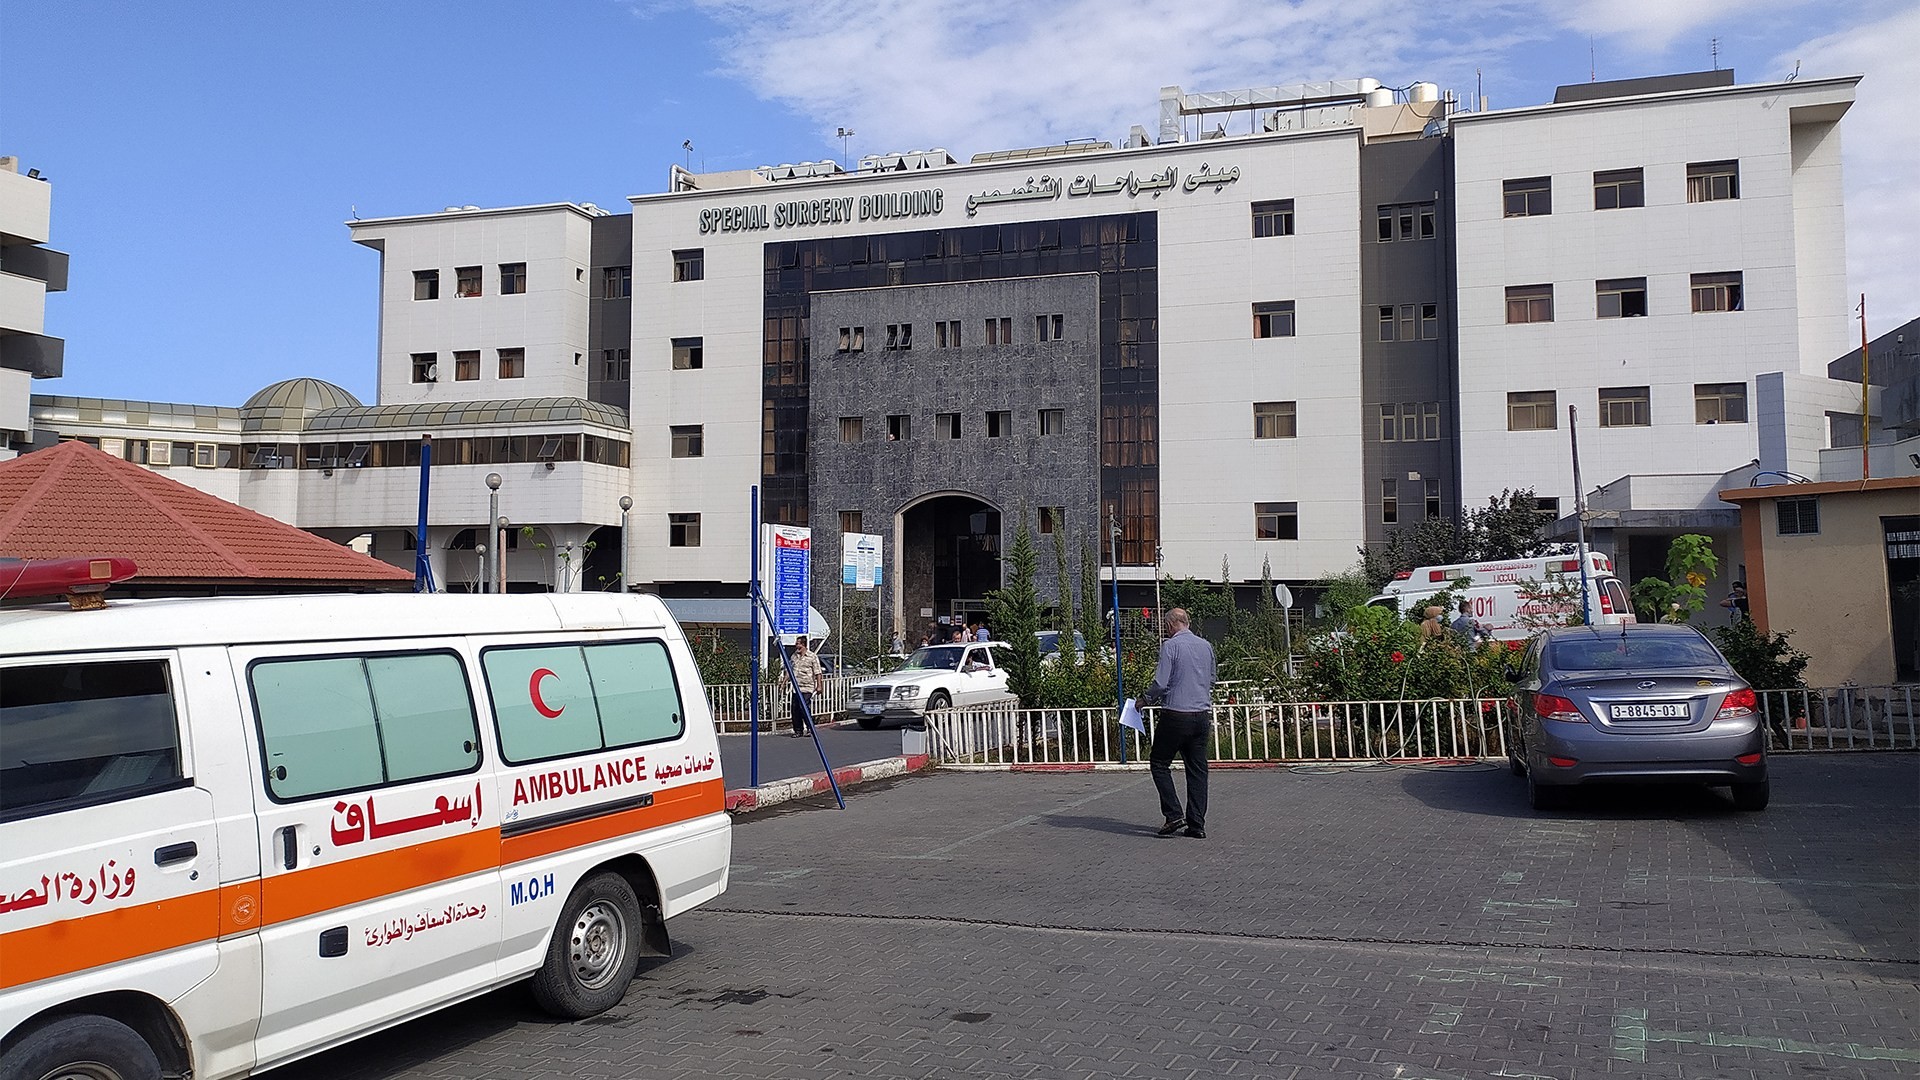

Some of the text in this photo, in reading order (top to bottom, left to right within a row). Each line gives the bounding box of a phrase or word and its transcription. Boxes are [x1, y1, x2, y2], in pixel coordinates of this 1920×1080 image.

[700, 188, 944, 233] SPECIAL SURGERY BUILDING
[967, 162, 1241, 218] مبنى الجراحات التخصصي
[1614, 705, 1676, 717] 3-8845-03
[513, 756, 647, 806] AMBULANCE
[685, 752, 714, 774] خدمات
[330, 780, 482, 846] إسعاف
[79, 859, 136, 905] وزارة
[511, 873, 554, 906] M.O.H
[455, 902, 487, 919] وحدة
